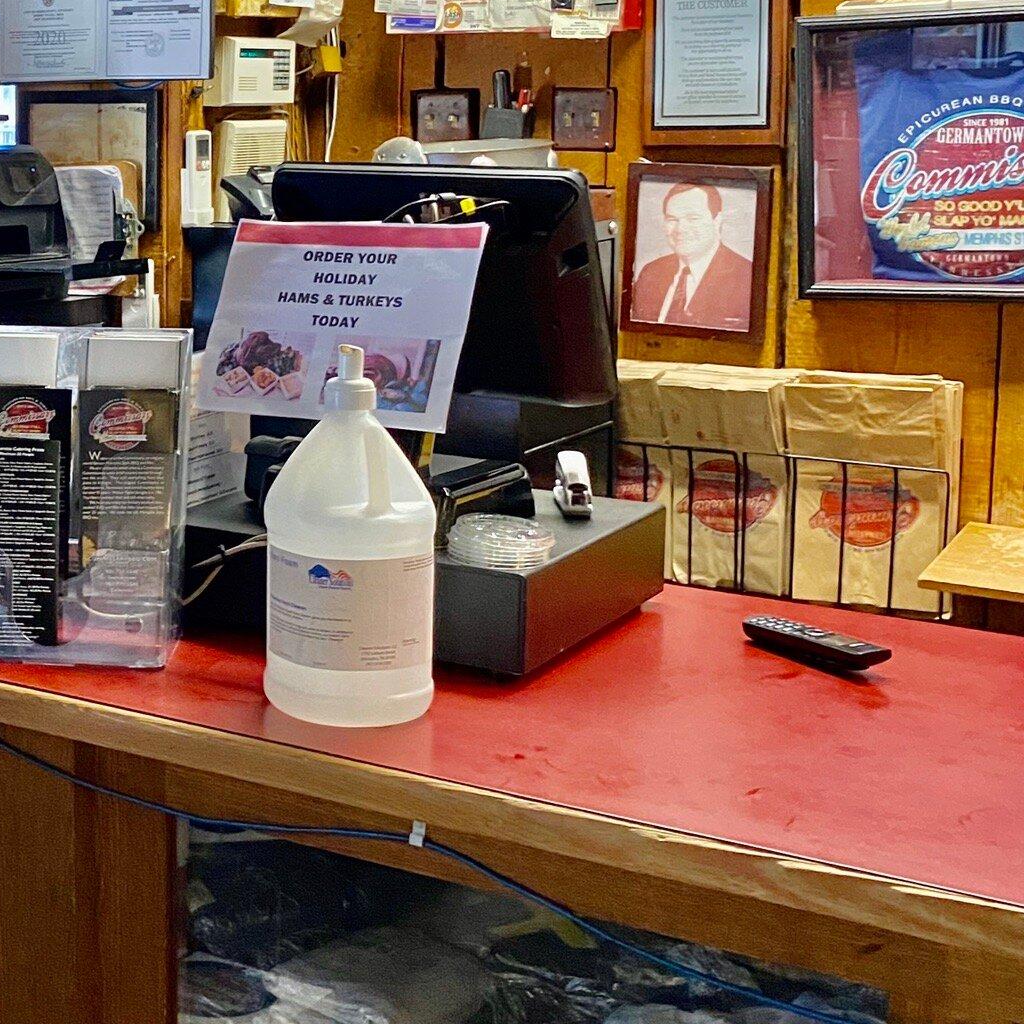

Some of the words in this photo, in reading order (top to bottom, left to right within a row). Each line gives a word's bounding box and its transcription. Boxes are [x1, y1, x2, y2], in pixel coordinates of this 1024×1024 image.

[676, 0, 695, 11] THE
[897, 95, 983, 144] EPICUREAN
[989, 94, 1024, 108] BBQ
[963, 118, 987, 127] SINCE
[989, 118, 1009, 126] 1981
[933, 200, 955, 212] SO
[957, 200, 1003, 212] GOOD
[933, 215, 970, 227] SLAP
[965, 232, 1012, 246] MEMPHIS
[303, 250, 353, 264] ORDER
[358, 251, 398, 265] YOUR
[313, 272, 377, 286] HOLIDAY
[277, 292, 319, 305] HAMS
[323, 293, 334, 306] &
[338, 294, 403, 308] TURKEYS
[312, 315, 360, 329] TODAY
